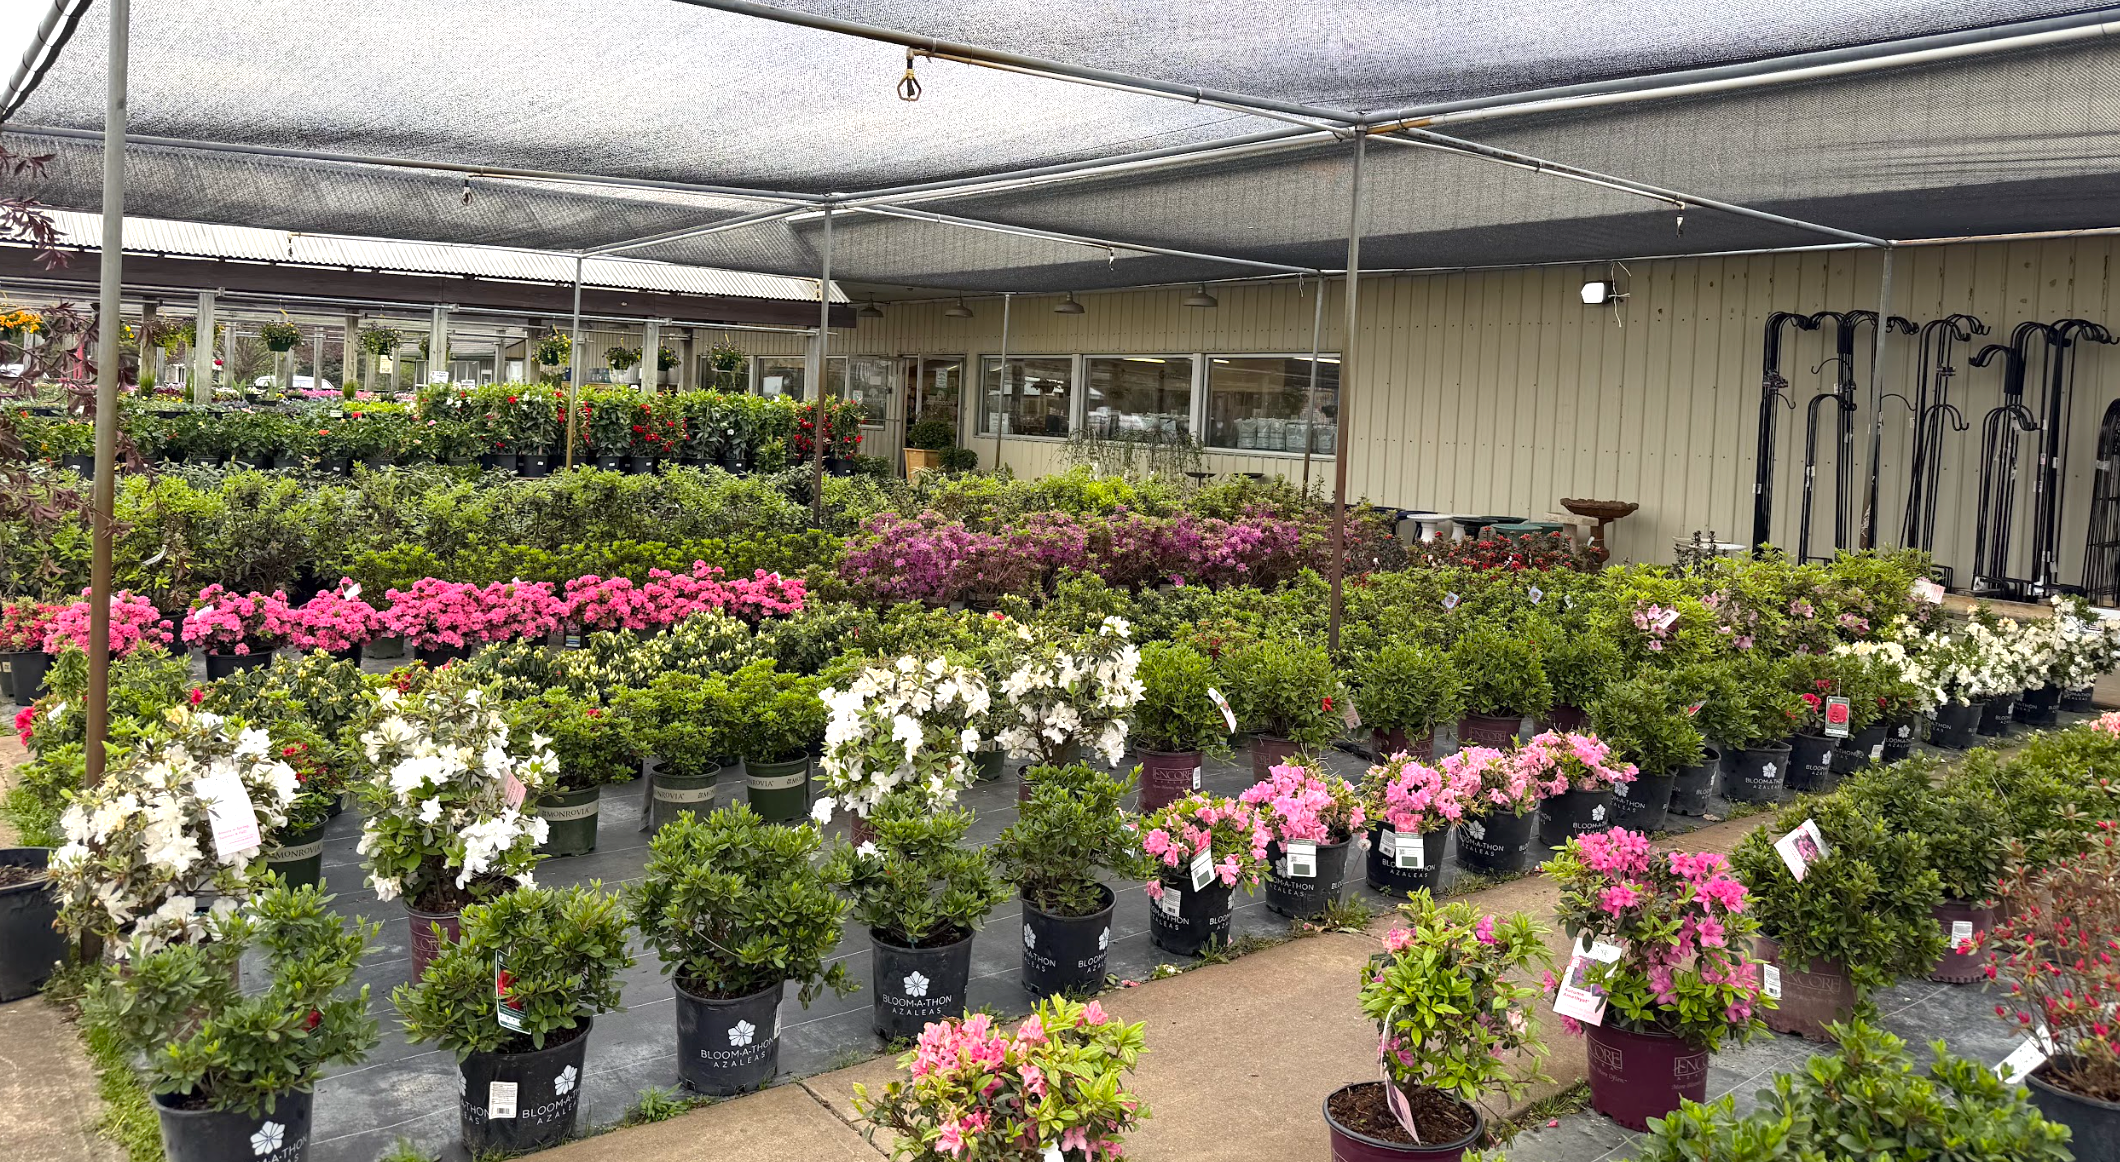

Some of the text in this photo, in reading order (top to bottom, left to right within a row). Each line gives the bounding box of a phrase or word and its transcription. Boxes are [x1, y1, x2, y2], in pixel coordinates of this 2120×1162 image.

[546, 806, 590, 818] MONROVIA
[275, 844, 321, 860] MONROVIA
[1389, 869, 1428, 878] AZALEAS
[892, 1007, 942, 1016] AZALEAS
[713, 1050, 766, 1068] AZALEAS
